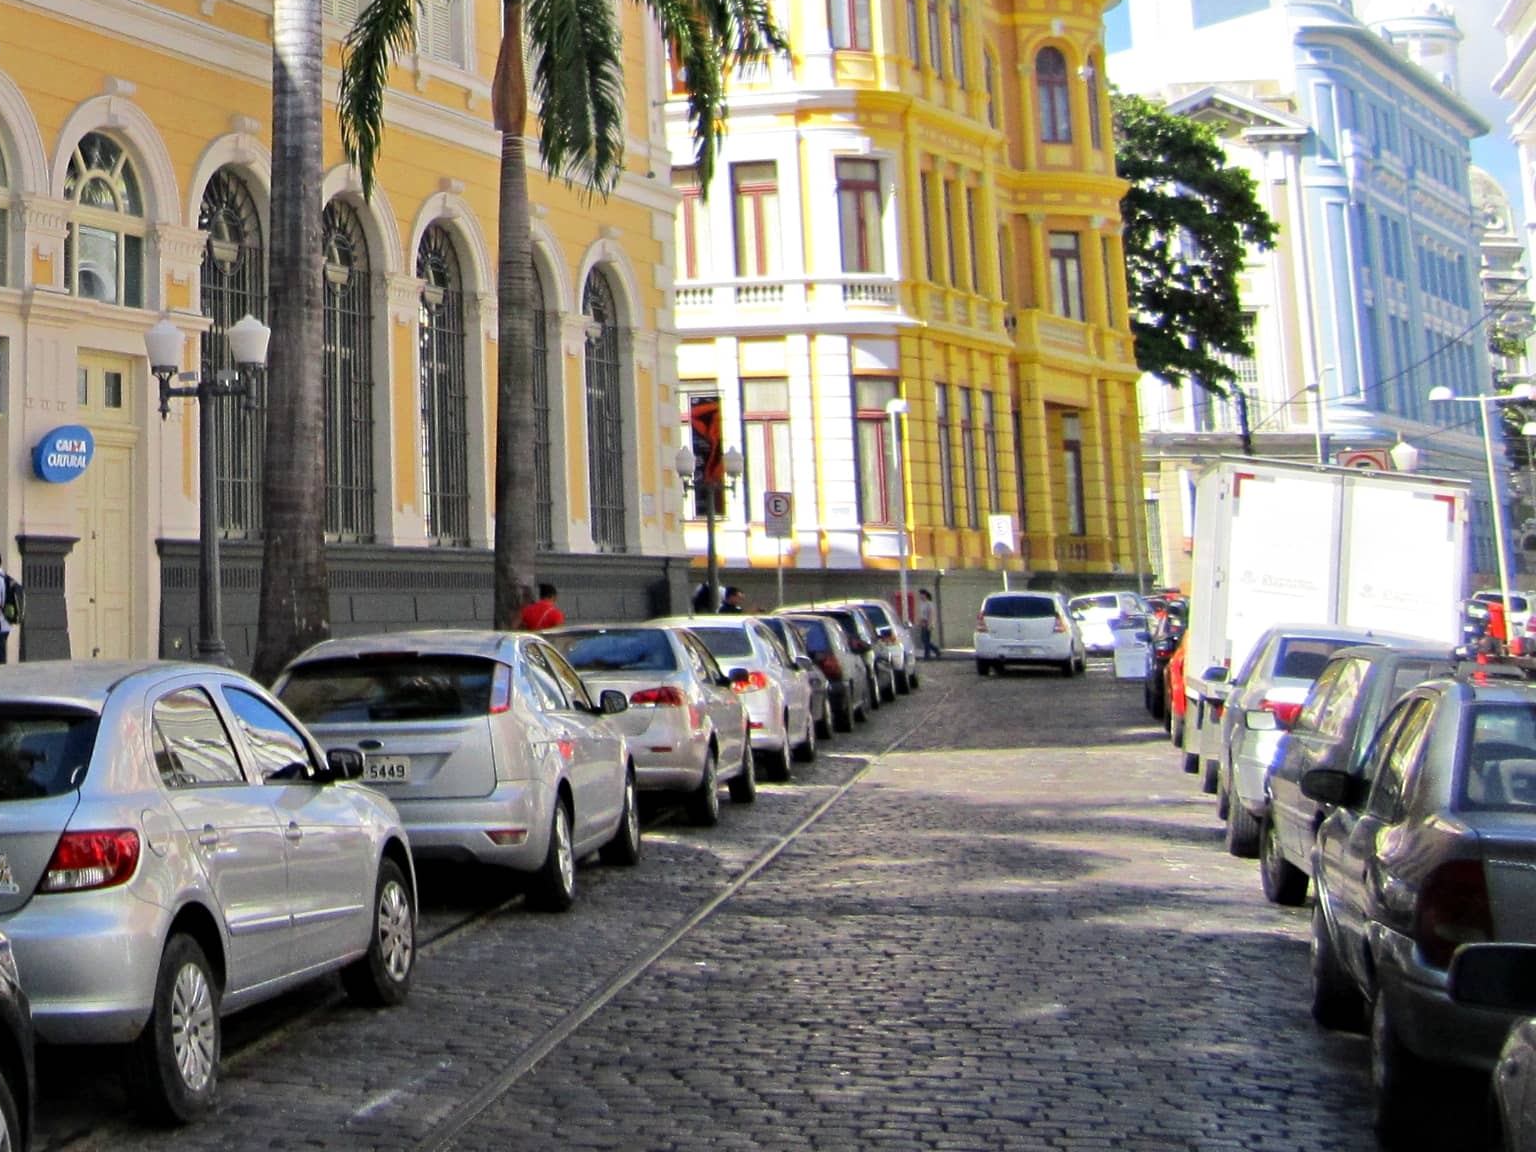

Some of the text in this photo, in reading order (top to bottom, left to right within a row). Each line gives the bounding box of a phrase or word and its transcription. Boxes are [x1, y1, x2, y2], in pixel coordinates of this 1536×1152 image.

[56, 439, 86, 453] CAIXA
[48, 453, 86, 468] CULTURAL
[774, 499, 782, 513] E
[370, 764, 405, 779] 5449
